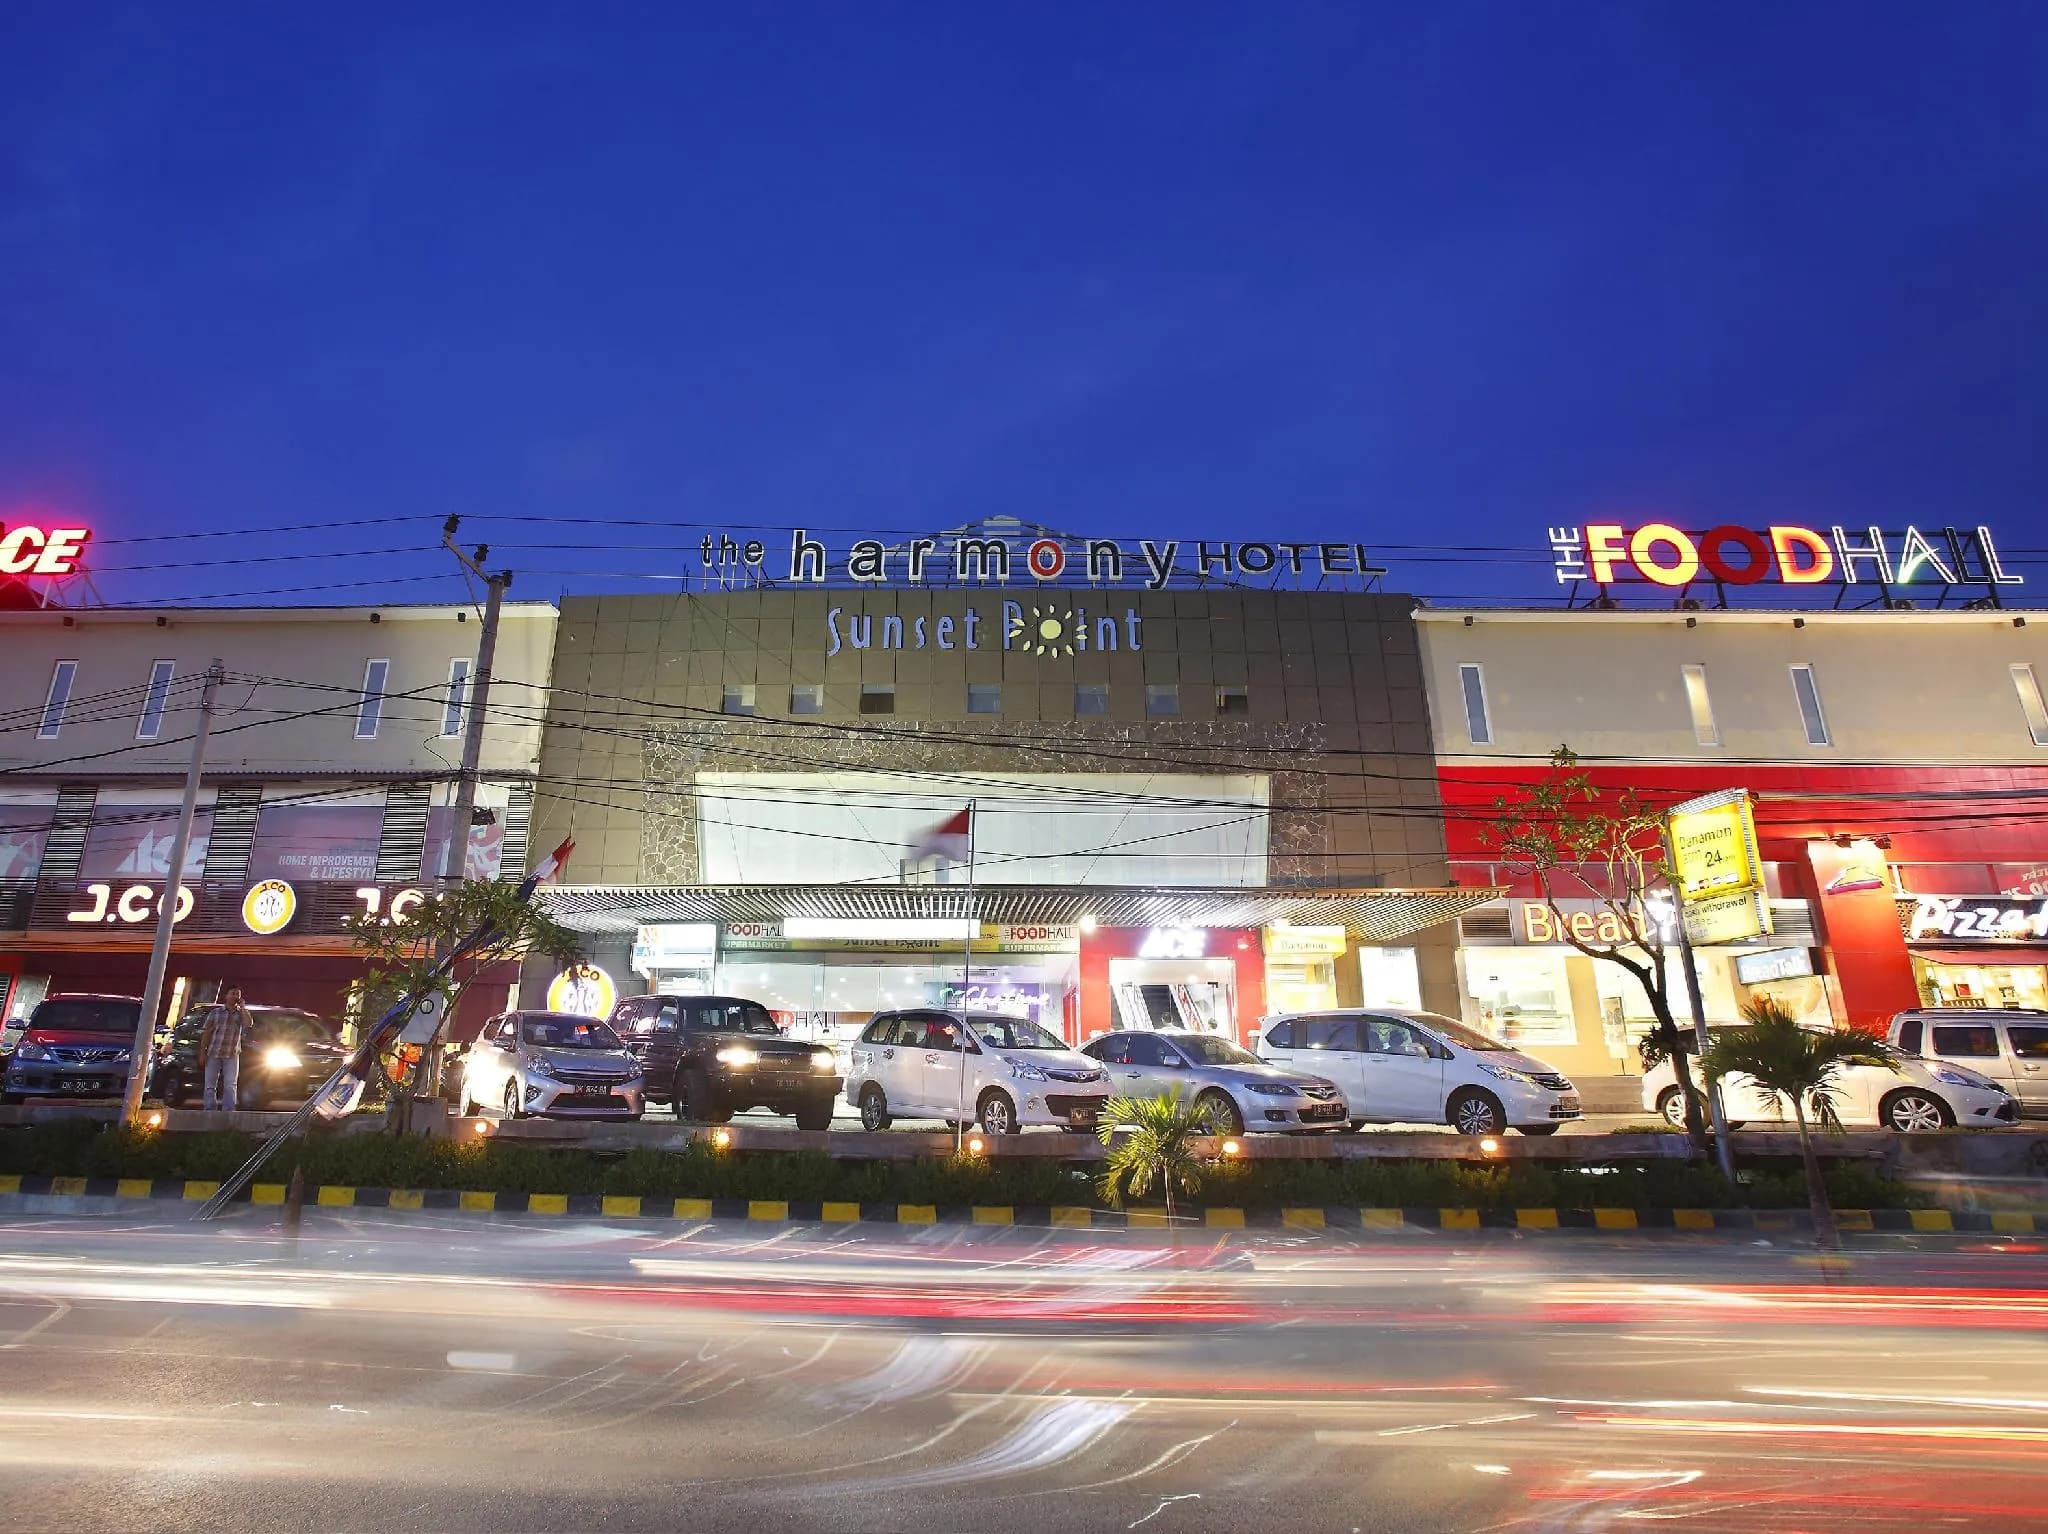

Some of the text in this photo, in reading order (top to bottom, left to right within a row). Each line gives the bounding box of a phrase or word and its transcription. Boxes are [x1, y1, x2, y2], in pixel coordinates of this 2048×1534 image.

[0, 525, 90, 574] CE
[701, 529, 1389, 590] the harmony HOTEL
[1549, 526, 1588, 584] THE
[827, 607, 980, 657] Sunset
[1679, 827, 1732, 850] Danamon
[1704, 849, 1723, 867] 24
[279, 855, 378, 866] HOME IMPROVEMEN
[310, 866, 319, 879] &
[66, 884, 195, 924] J.CO
[1523, 896, 1650, 943] Bread
[1910, 896, 2026, 939] Pizza
